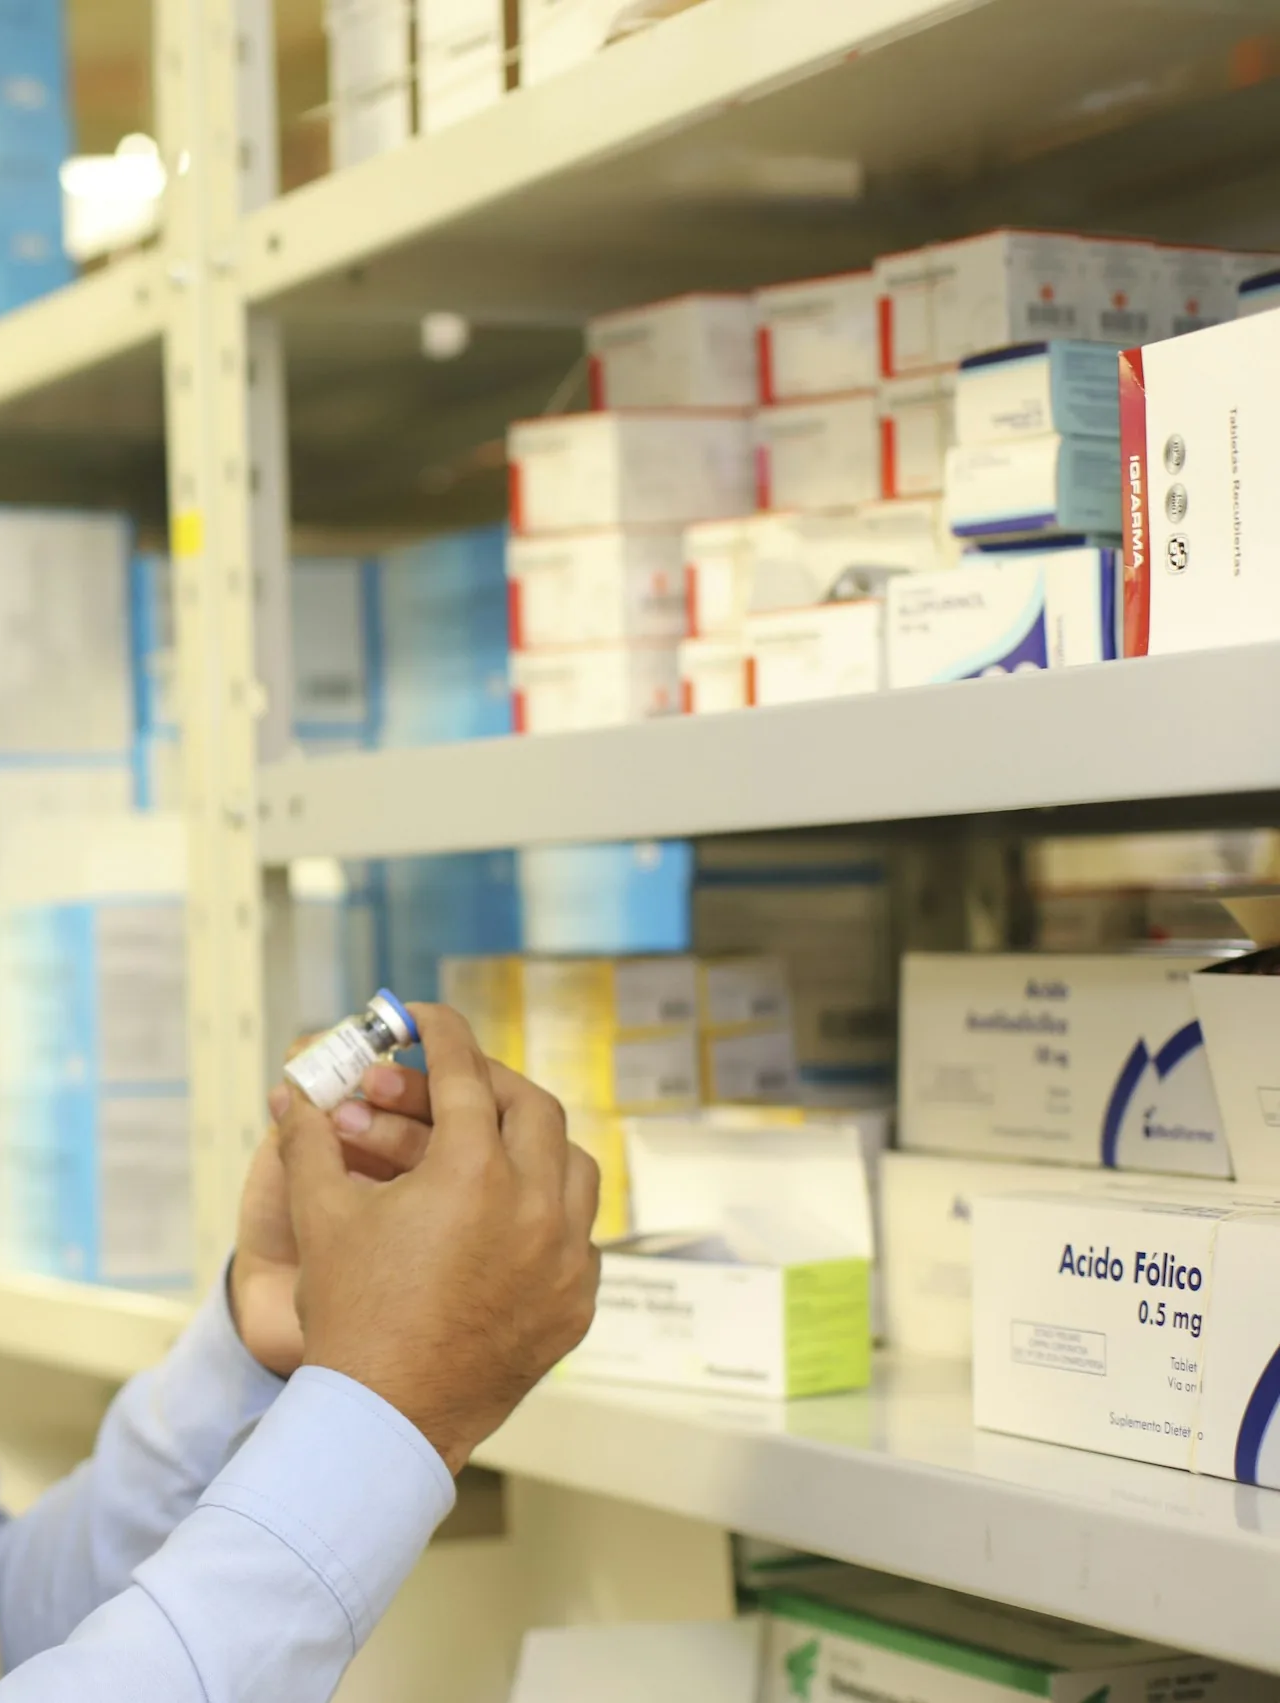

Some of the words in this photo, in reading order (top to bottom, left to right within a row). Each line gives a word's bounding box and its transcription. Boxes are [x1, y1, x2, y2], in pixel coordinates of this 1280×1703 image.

[1058, 1244, 1123, 1282] Acido
[1133, 1251, 1202, 1291] Fólico
[1138, 1300, 1166, 1326] 0.5
[1172, 1310, 1202, 1338] mg
[1170, 1356, 1198, 1373] Tablet
[1109, 1411, 1161, 1432] Suplemento
